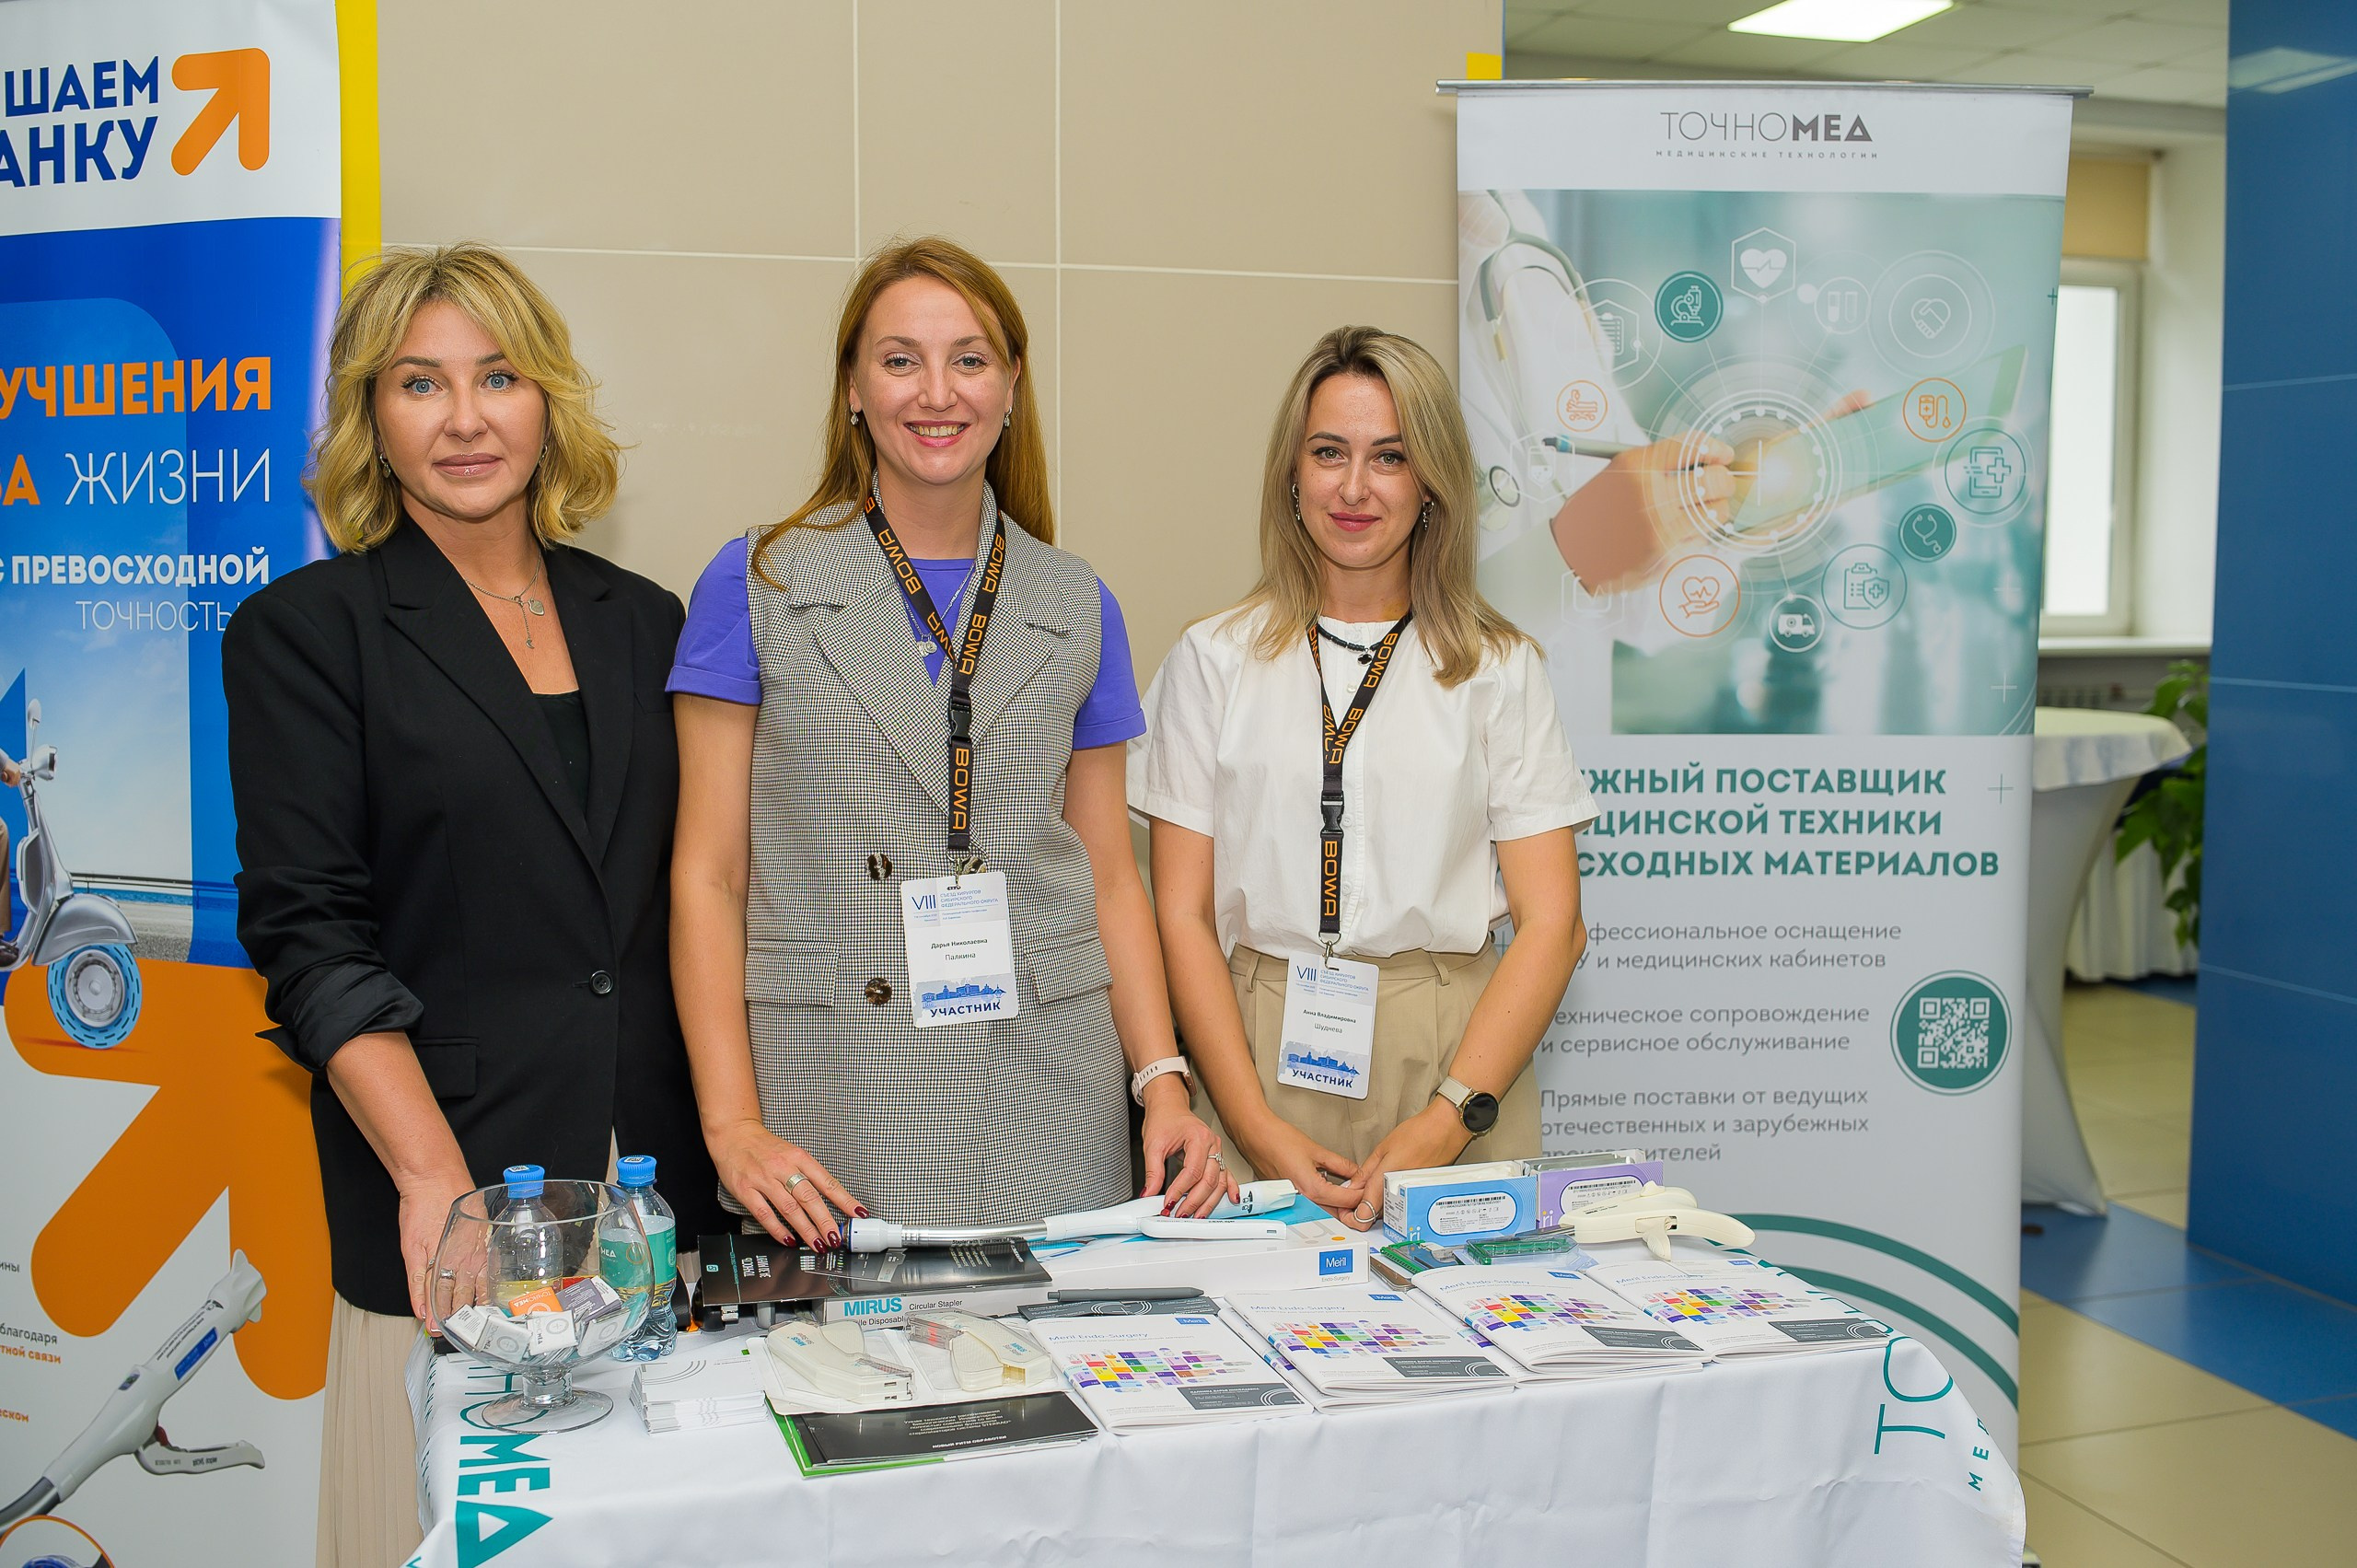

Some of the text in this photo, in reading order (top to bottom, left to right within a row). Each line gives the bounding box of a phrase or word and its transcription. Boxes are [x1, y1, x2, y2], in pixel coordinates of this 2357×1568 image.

[5, 56, 158, 117] ШАЕМ
[1660, 111, 1873, 142] ТОЧНОМЕД
[1655, 150, 1767, 158] МЕДИЦИНСКИЕ
[64, 448, 270, 505] ЖИЗНИ
[12, 546, 269, 587] ПРЕВОСХОДНОЙ
[878, 528, 922, 595] BOWA
[982, 533, 1004, 594] BOWA
[75, 600, 240, 632] ТОЧНОСТЬ
[960, 613, 987, 676] BOWA
[1364, 633, 1399, 690] BOWA
[1329, 707, 1364, 765] BOWA
[953, 748, 970, 830] BOWA
[1581, 761, 1946, 796] ЖНЫЙ ПОСТАВЩИК
[1583, 803, 1942, 837] ЦИНСКОЙ ТЕХНИКИ
[1765, 852, 1999, 877] МАТЕРИАЛОВ
[1324, 841, 1338, 916] BOWA
[911, 895, 936, 910] VIII
[931, 937, 988, 949] Дарья Николаевна
[1774, 924, 1902, 942] оснащение
[1597, 956, 1609, 969] и
[1617, 952, 1762, 970] медицинских
[1770, 948, 1886, 968] кабинетов
[1296, 965, 1317, 981] VIII
[930, 1001, 1001, 1017] УЧАСТНИК
[1318, 1012, 1356, 1024] Владимировна
[1689, 1007, 1869, 1027] сопровождение
[1540, 1033, 1851, 1058] и сервисное обслуживание
[1293, 1069, 1353, 1088] УЧАСТНИК
[1540, 1089, 1868, 1113] Прямые поставки от ведущих
[1541, 1113, 1869, 1138] отечественных и зарубежных
[1326, 1256, 1346, 1268] Meril
[909, 1302, 936, 1311] Circular
[938, 1299, 963, 1308] Stapler
[868, 1316, 904, 1326] Disposabl
